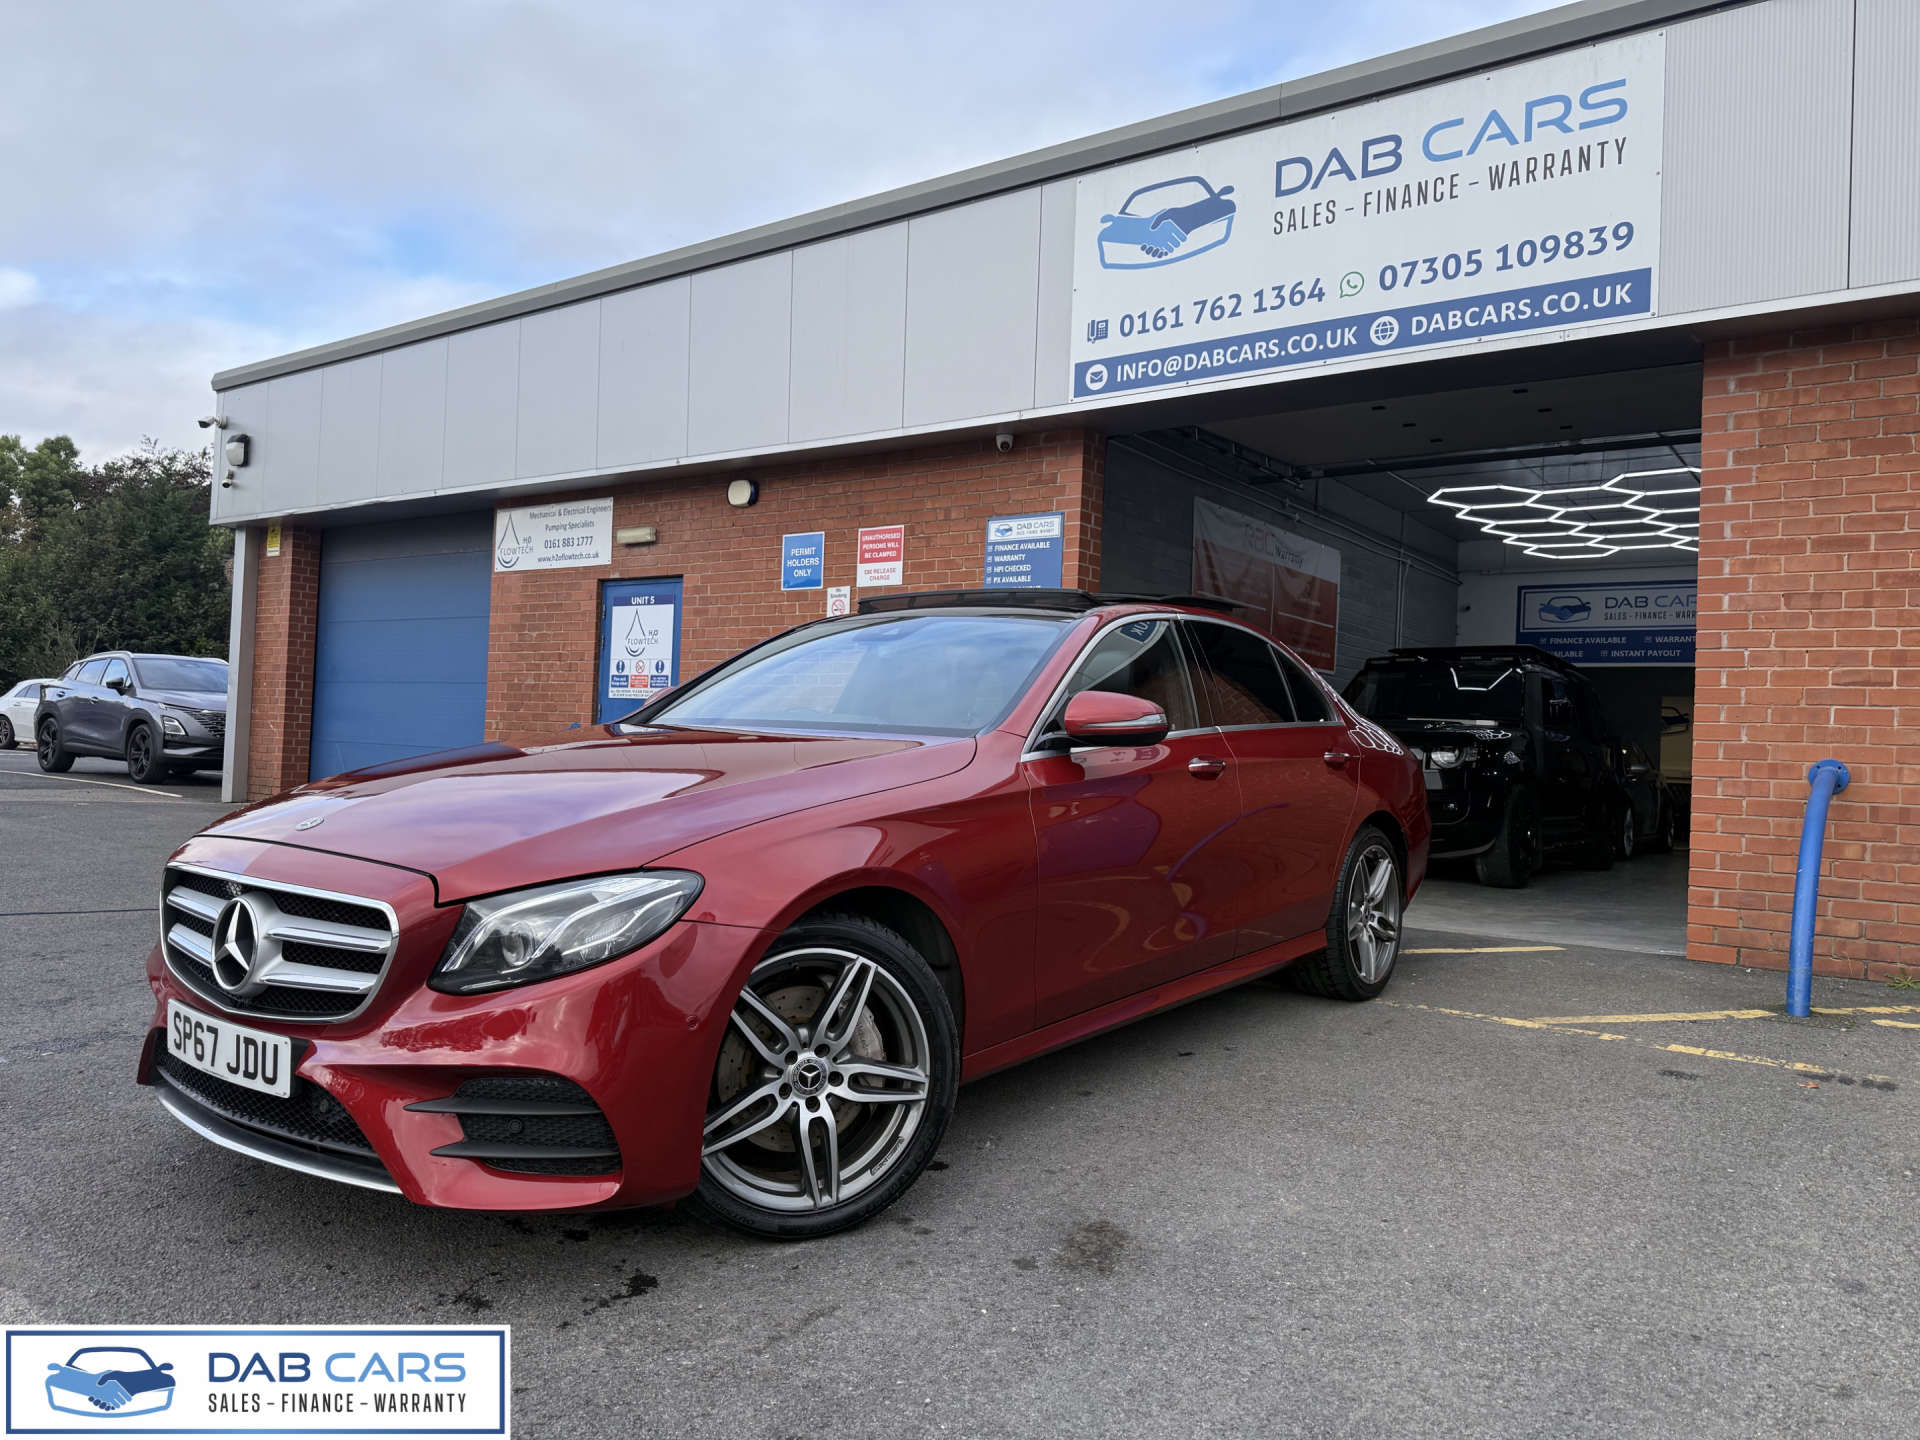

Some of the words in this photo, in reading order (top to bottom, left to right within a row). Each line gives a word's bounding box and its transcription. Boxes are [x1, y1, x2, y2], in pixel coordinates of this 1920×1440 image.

[1275, 134, 1402, 198] DAB
[1422, 79, 1628, 162] CARS
[1273, 200, 1336, 235] SALES
[1364, 173, 1459, 217] FINANCE
[1489, 137, 1626, 191] WARRANTY
[1379, 249, 1483, 291] 07305
[1496, 221, 1634, 272] 109839
[1119, 304, 1184, 338] 0161
[1193, 293, 1241, 324] 762
[1252, 278, 1326, 313] 1364
[1411, 282, 1632, 335] DABCARS.CO.UK
[1117, 326, 1357, 383] INFO@DABCARS.CO.UK
[544, 538, 560, 549] 0161
[562, 537, 574, 547] 883
[577, 535, 593, 546] 1777
[994, 543, 1019, 551] FINANCE
[1020, 541, 1050, 550] AVAILABLE
[500, 545, 534, 556] FLOWTECH
[791, 546, 816, 557] PERMIT
[872, 550, 896, 558] CLAMPED
[787, 557, 819, 567] HOLDERS
[994, 553, 1025, 562] WARRANTY
[793, 568, 812, 577] ONLY
[1004, 564, 1032, 572] CHECKED
[1002, 575, 1032, 583] AVAILABLE
[631, 596, 649, 604] UNIT
[650, 596, 655, 604] 5
[1604, 596, 1649, 609] DAB
[1635, 610, 1666, 619] FINANCE
[1675, 609, 1697, 619] WARR
[1584, 636, 1627, 644] AVAILABLE
[1655, 635, 1697, 643] WARRANT
[1611, 648, 1644, 656] INSTANT
[1647, 648, 1680, 656] PAYOUT
[173, 1010, 219, 1067] SP67
[226, 1034, 279, 1086] JDU
